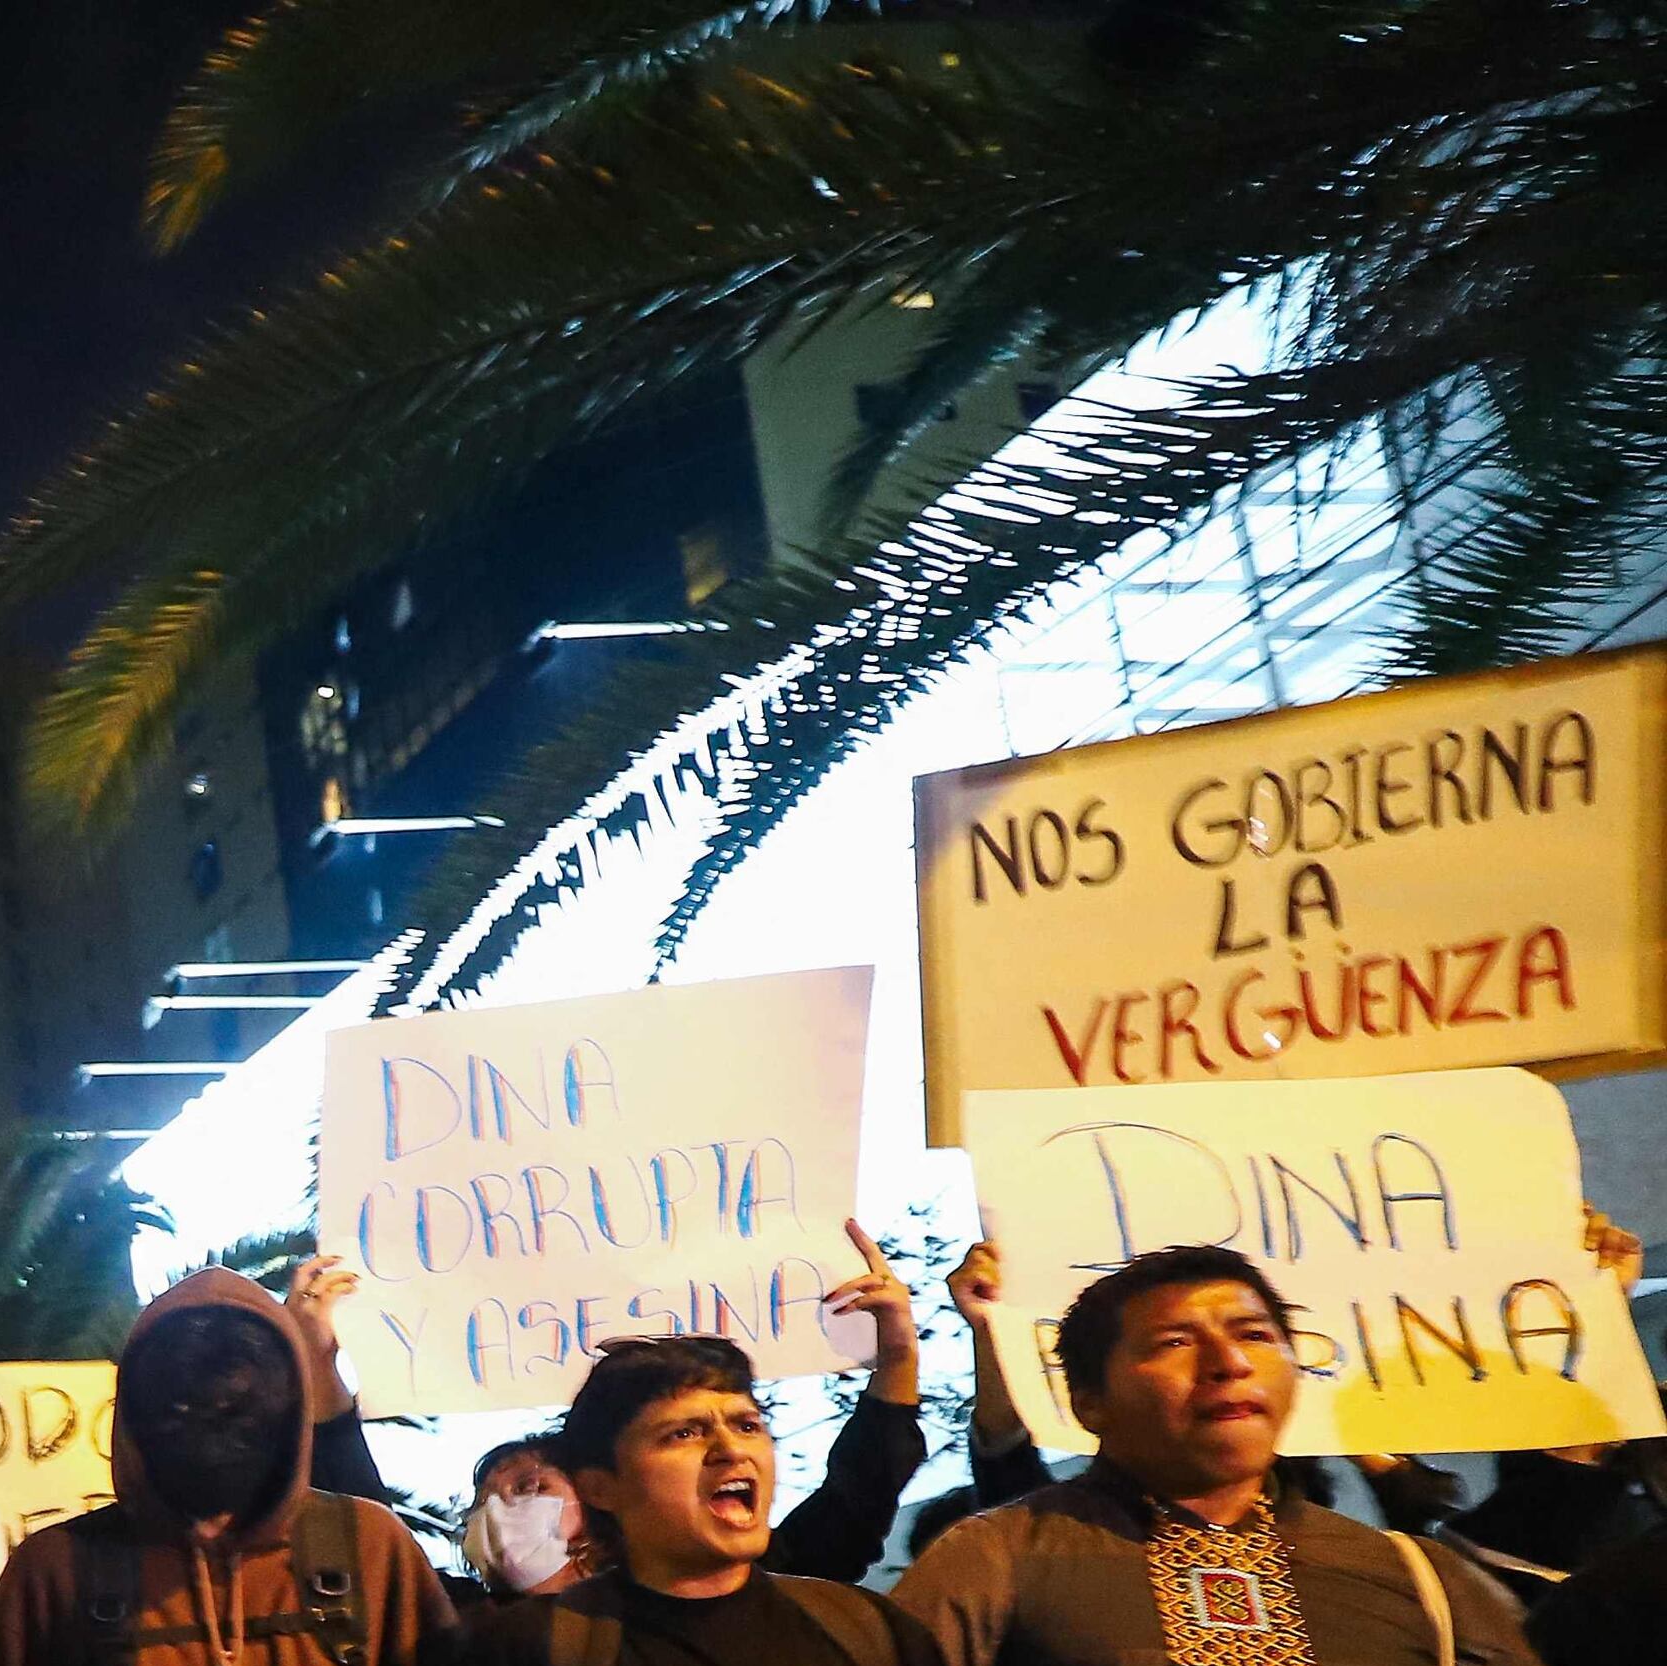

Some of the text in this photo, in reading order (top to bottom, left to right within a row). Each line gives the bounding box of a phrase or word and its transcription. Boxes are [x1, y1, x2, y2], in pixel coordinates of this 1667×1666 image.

[970, 710, 1598, 903] NOS GOBIERNA
[1213, 862, 1344, 958] LA
[1041, 924, 1579, 1086] VERGÜENZA
[380, 1037, 622, 1162] DINA
[357, 1137, 806, 1283] CORRUPTA
[1040, 1120, 1456, 1270] DINA
[378, 1257, 829, 1397] Y ASESINA
